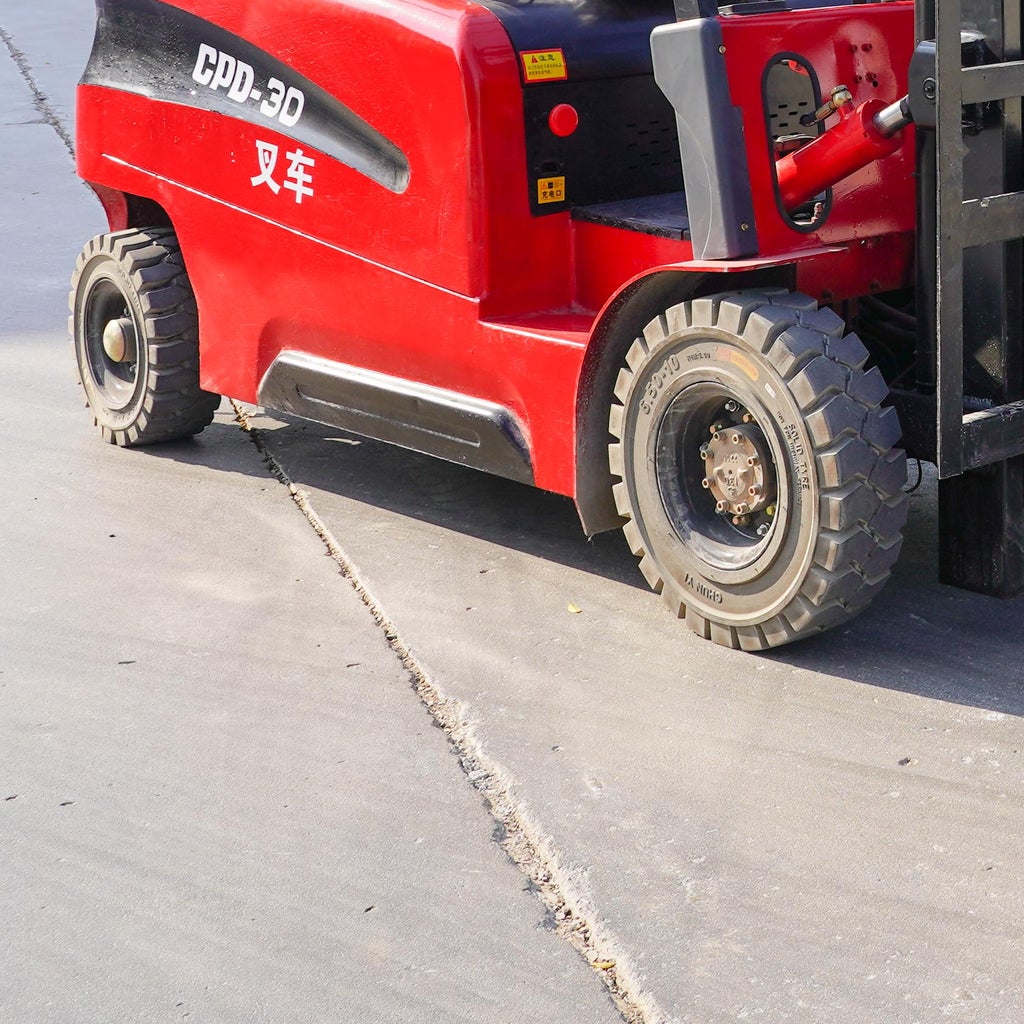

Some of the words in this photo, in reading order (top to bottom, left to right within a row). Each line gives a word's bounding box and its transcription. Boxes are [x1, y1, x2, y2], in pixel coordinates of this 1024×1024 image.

[192, 42, 305, 127] CPD-30
[250, 139, 315, 204] 叉车
[788, 424, 804, 456] SOLID
